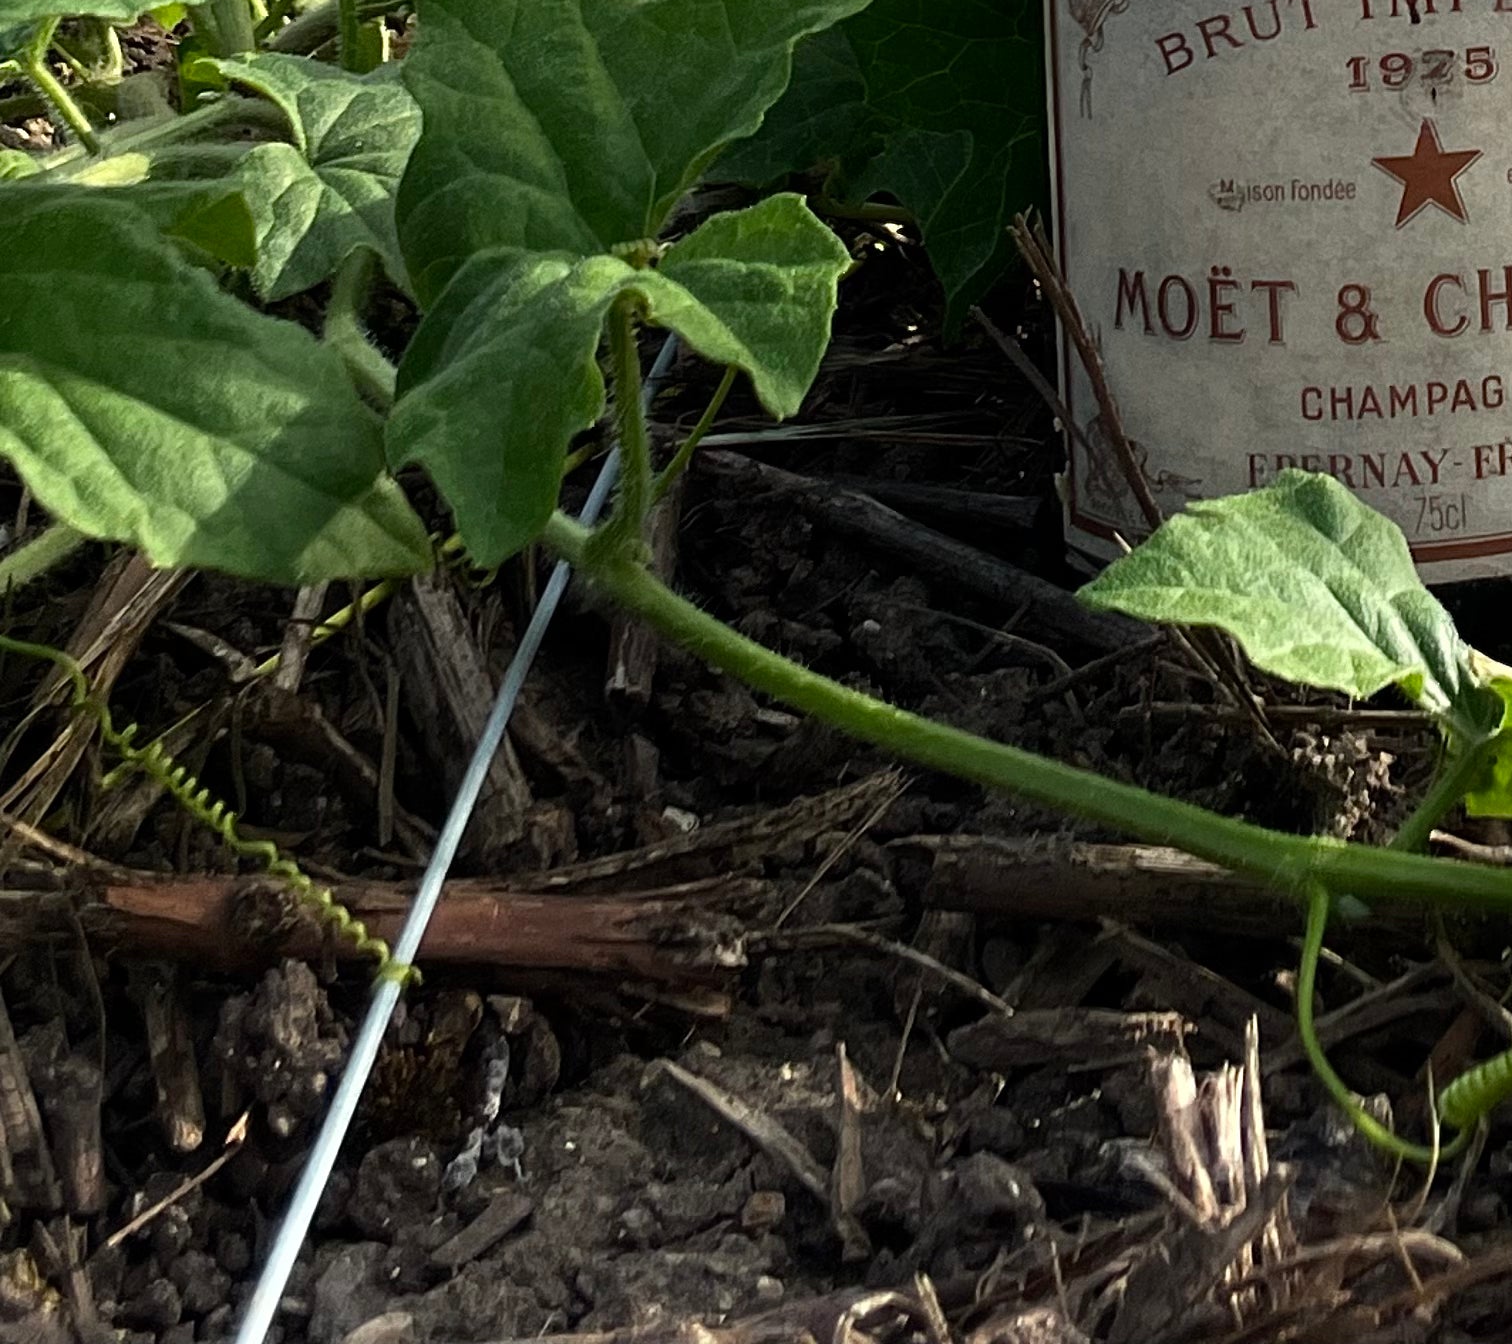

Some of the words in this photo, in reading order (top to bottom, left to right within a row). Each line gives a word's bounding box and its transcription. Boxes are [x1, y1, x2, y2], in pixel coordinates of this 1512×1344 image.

[1291, 177, 1357, 202] fondée
[1114, 265, 1298, 346] MOËT
[1336, 282, 1382, 346] &
[1413, 493, 1467, 534] 75cl
